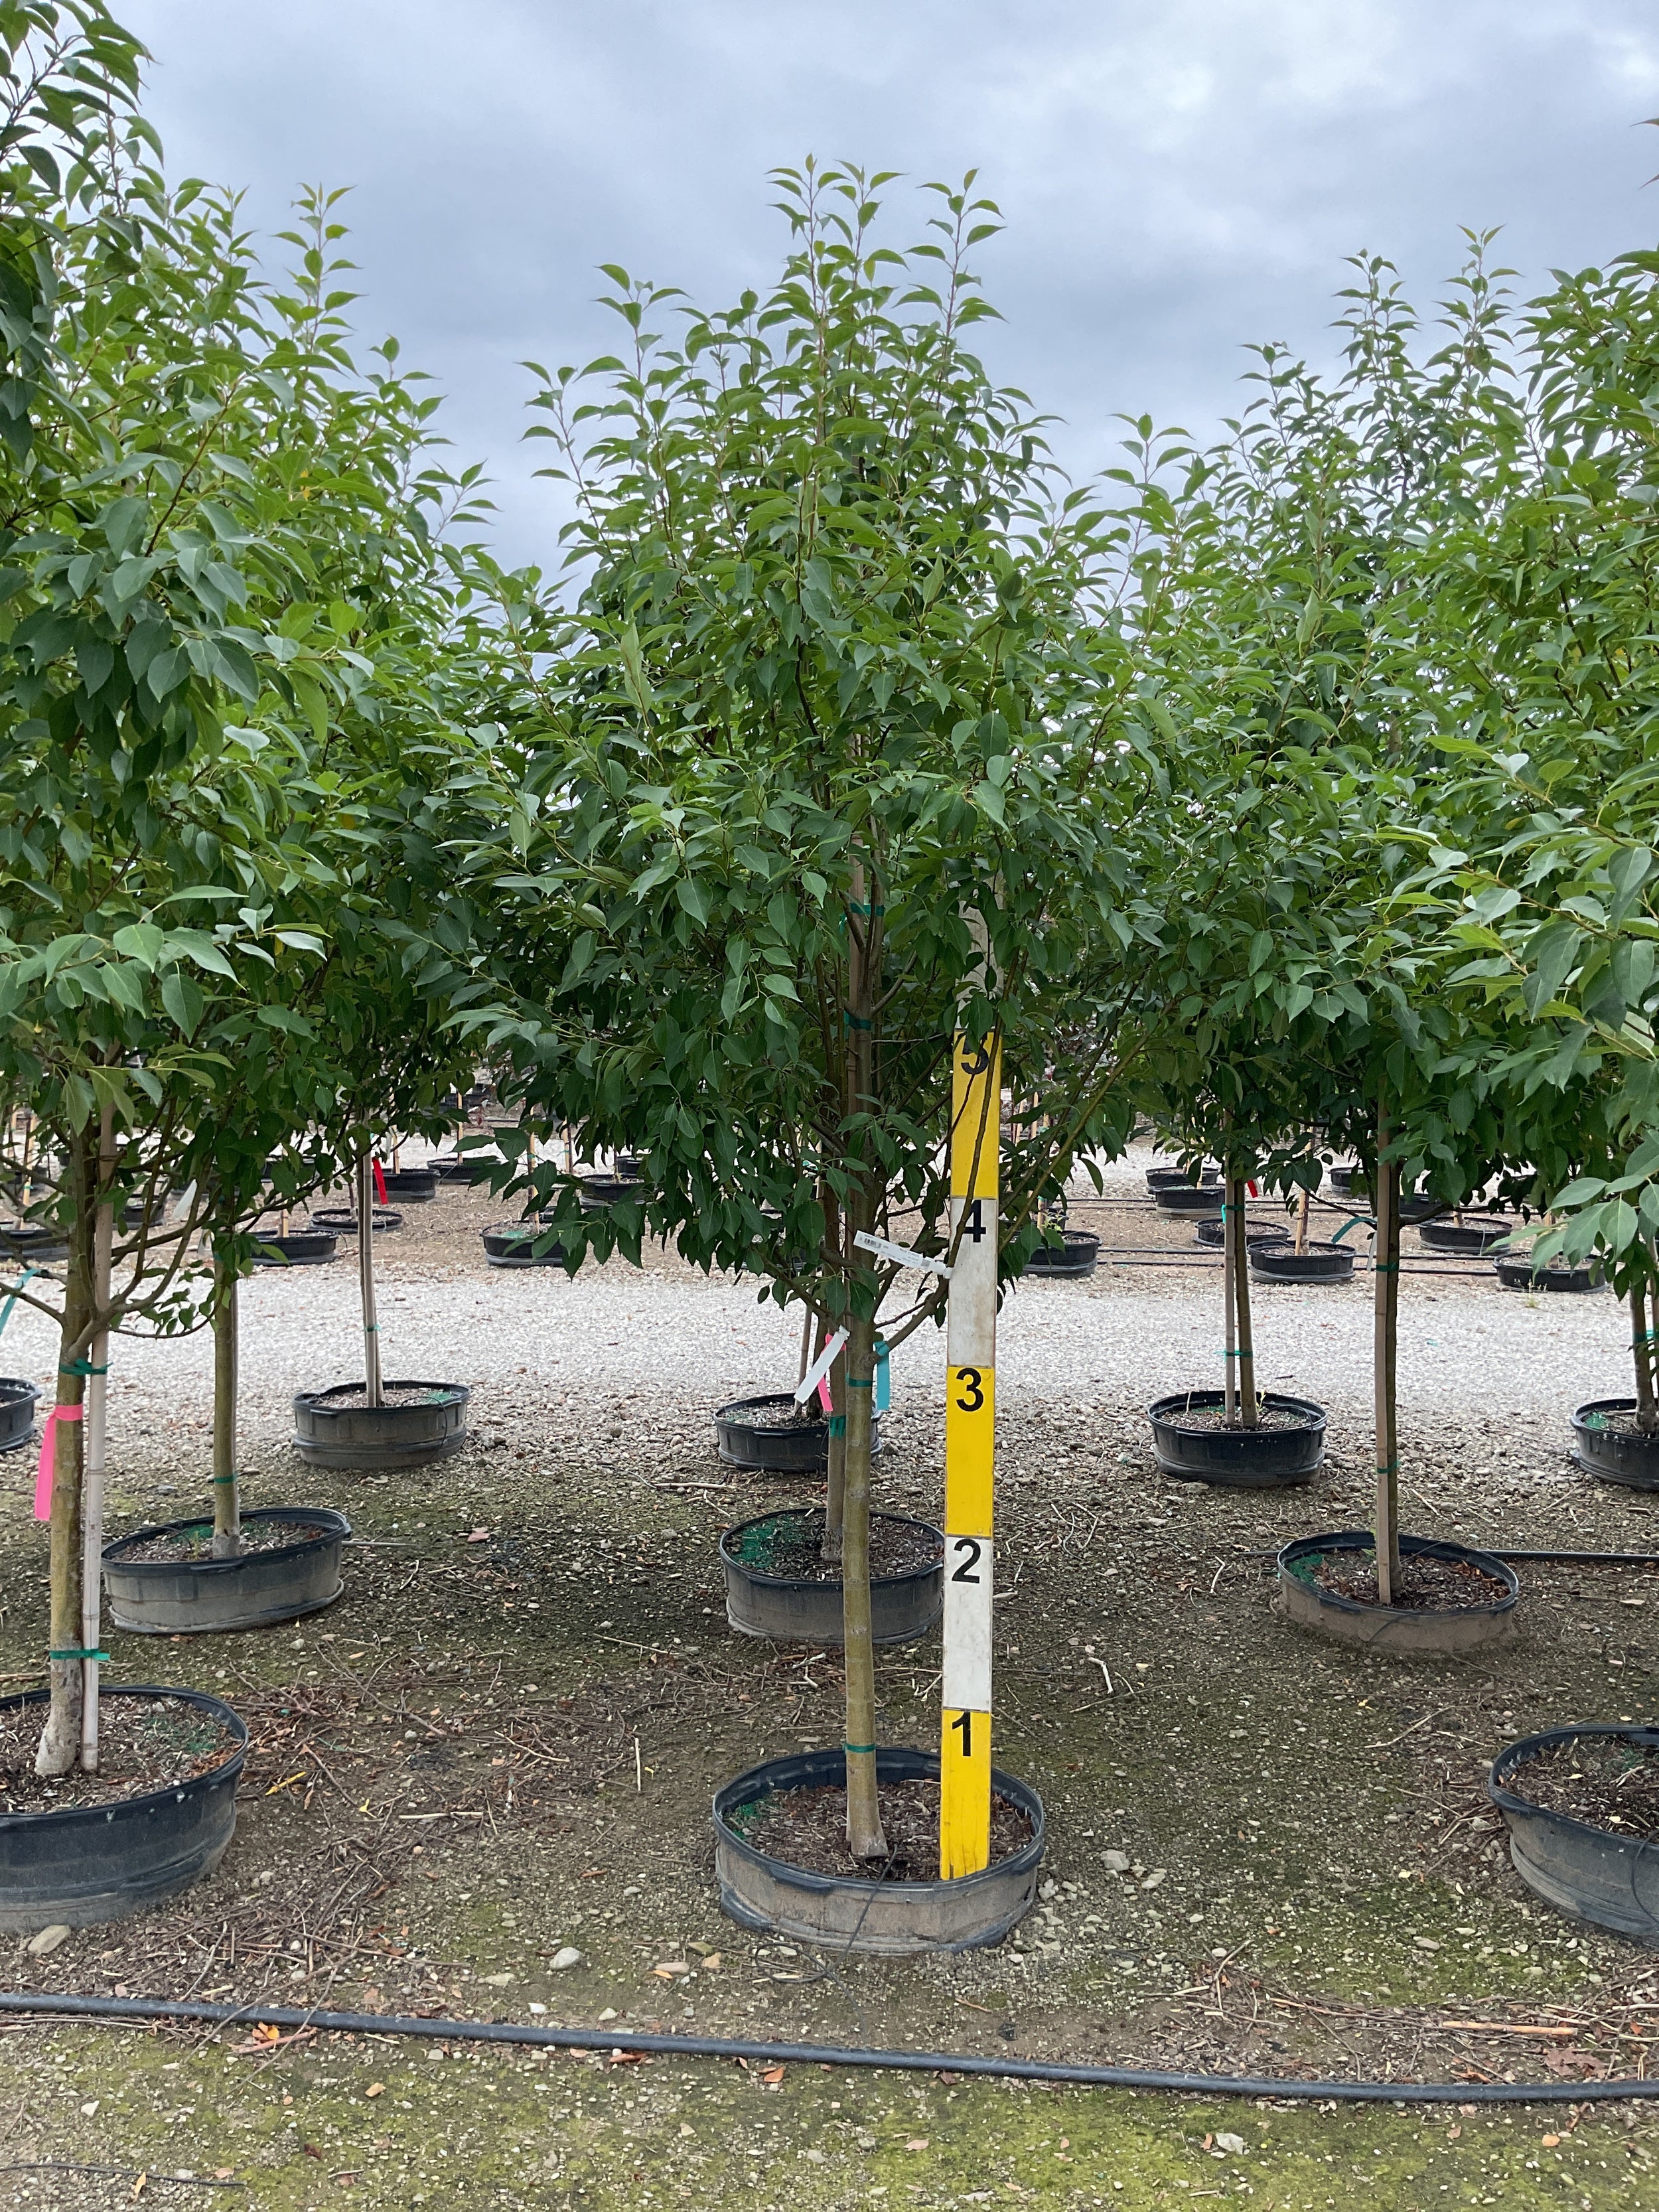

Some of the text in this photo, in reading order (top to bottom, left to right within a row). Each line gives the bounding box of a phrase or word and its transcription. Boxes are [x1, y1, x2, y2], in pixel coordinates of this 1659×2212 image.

[960, 1030, 989, 1075] 5
[961, 1199, 987, 1243] 4
[956, 1367, 984, 1412] 3
[952, 1538, 981, 1584] 2
[952, 1710, 972, 1757] 1
